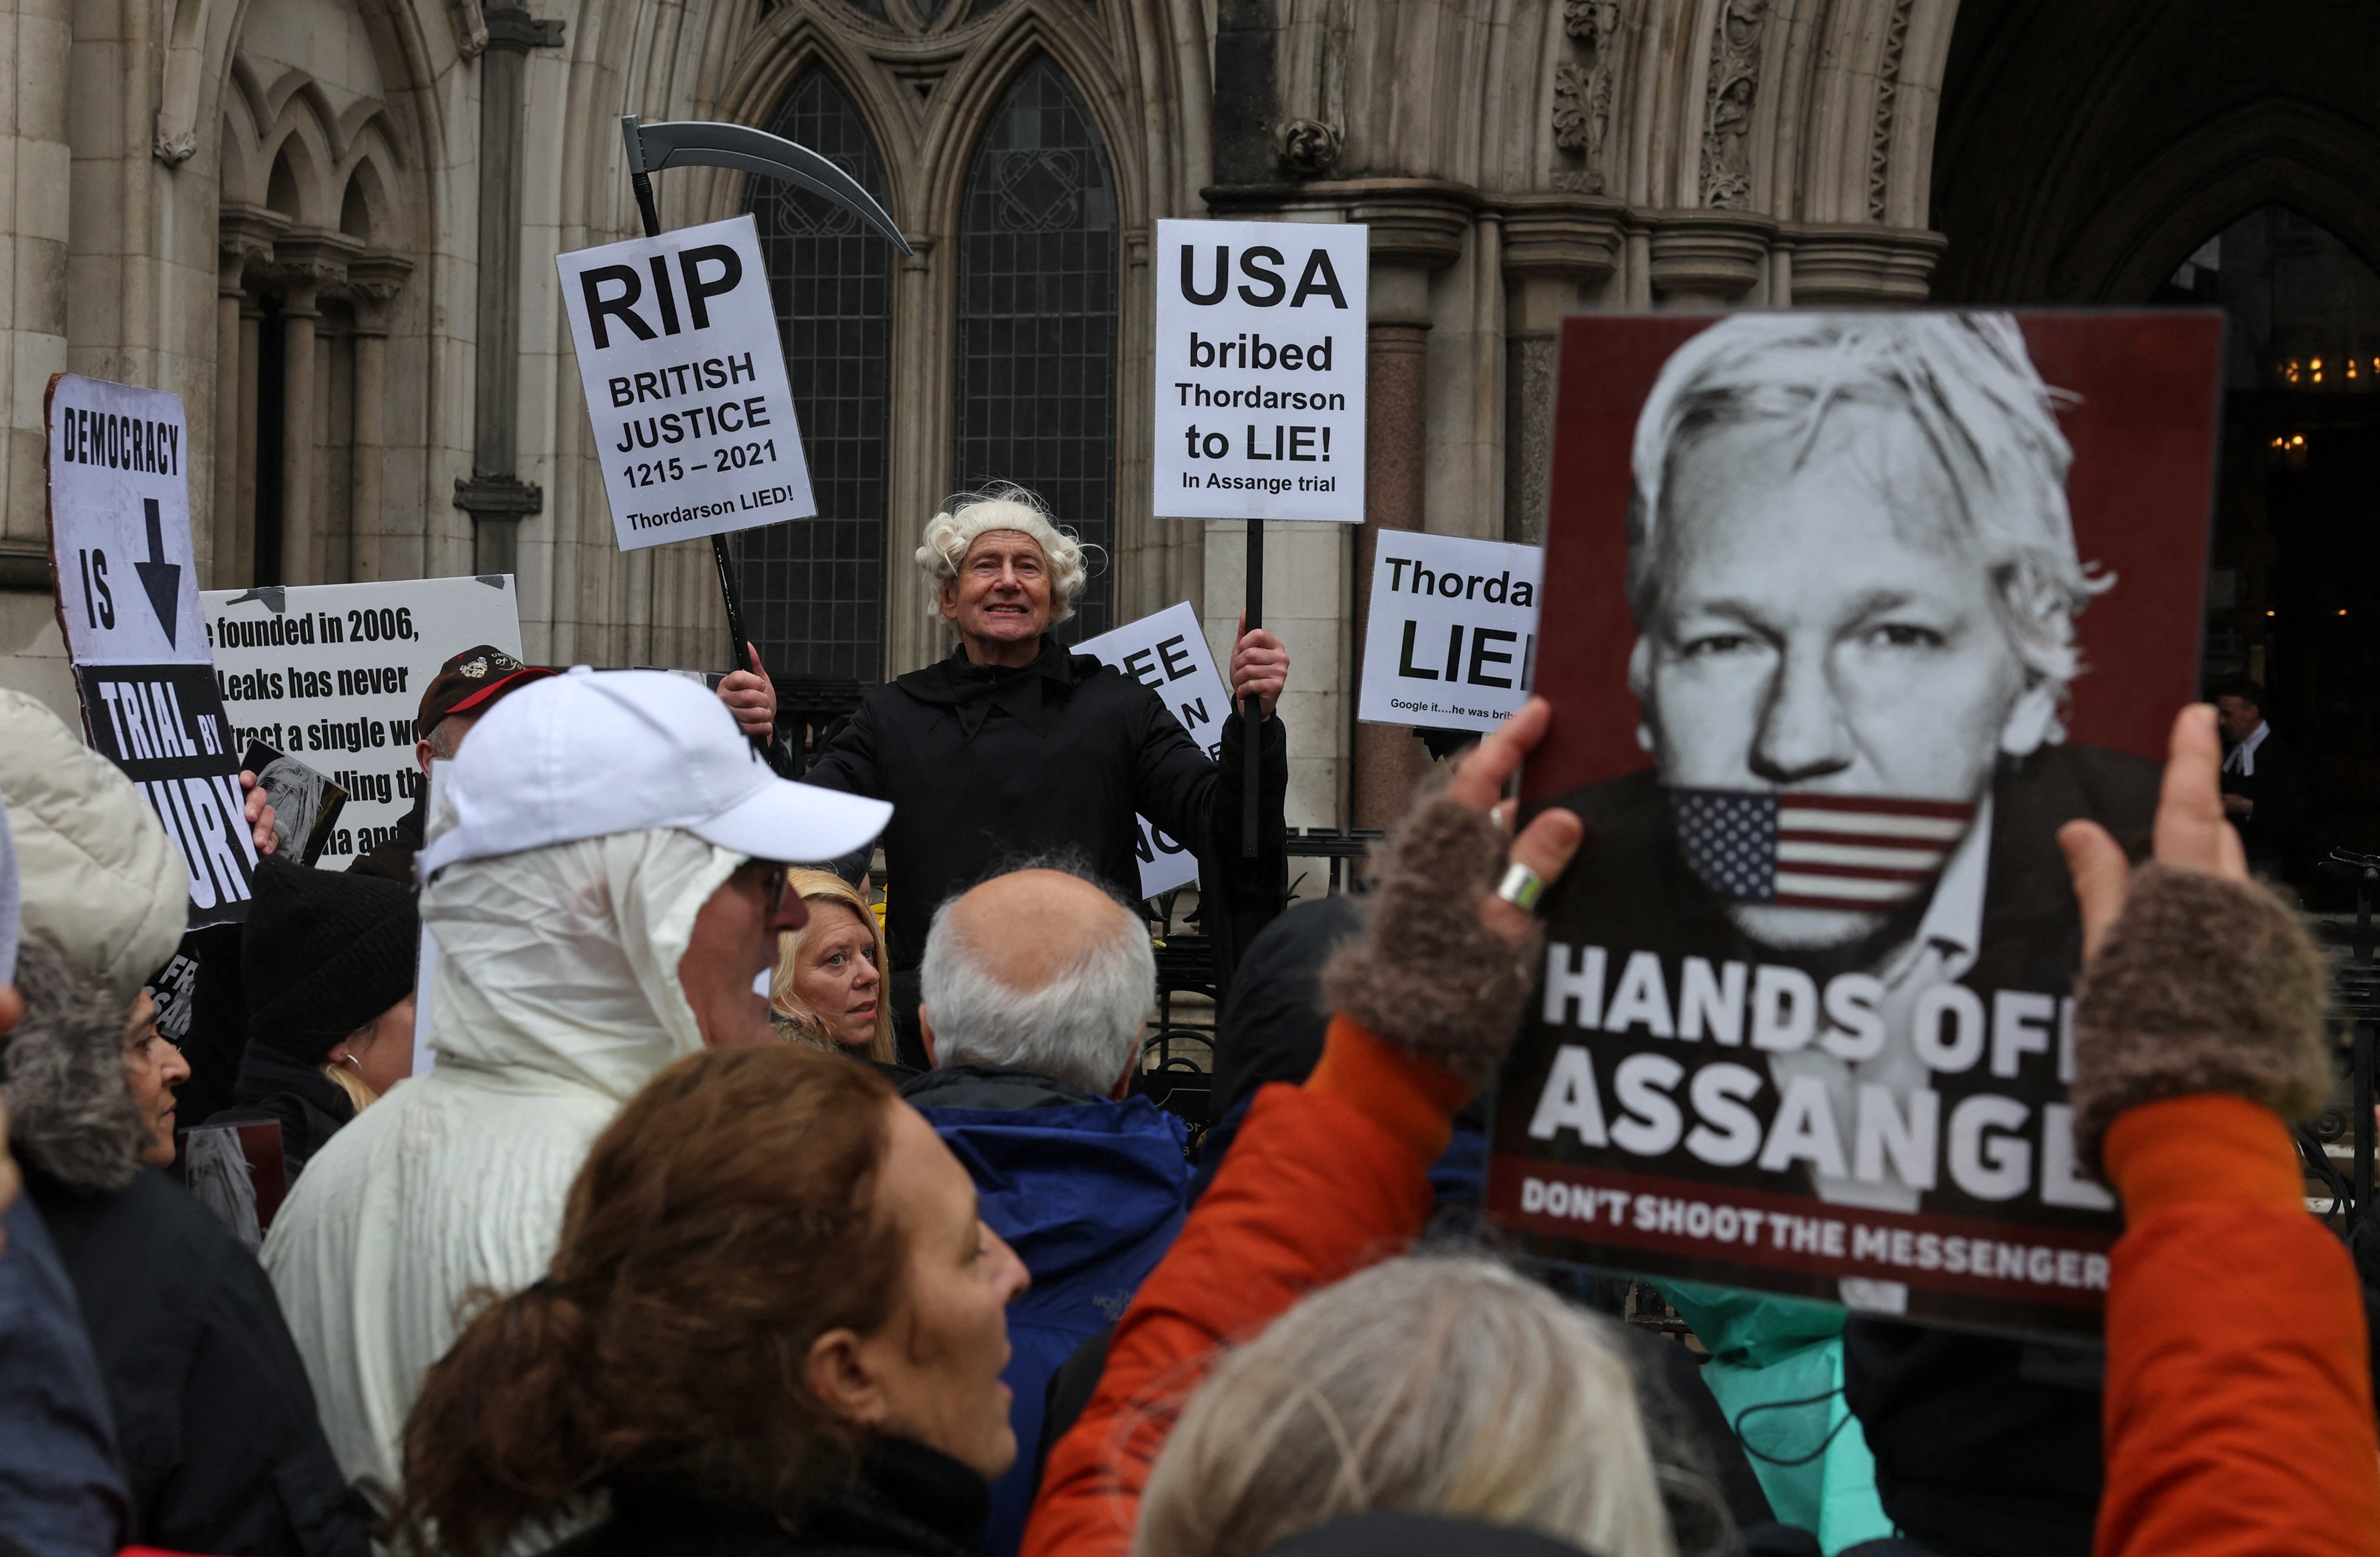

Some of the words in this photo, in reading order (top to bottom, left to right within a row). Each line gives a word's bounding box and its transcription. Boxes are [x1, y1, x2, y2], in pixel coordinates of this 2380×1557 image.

[580, 244, 743, 350] RIP
[1179, 245, 1348, 309] USA
[1189, 333, 1332, 371] bribed
[608, 352, 756, 408] BRITISH
[1175, 383, 1345, 411] Thordarson
[64, 407, 178, 475] DEMOCRACY
[616, 396, 771, 452] JUSTICE
[1185, 424, 1229, 459] to
[1247, 425, 1331, 462] LIE!
[624, 457, 684, 488] 1215
[714, 439, 777, 472] 2021
[1182, 472, 1200, 488] In
[1206, 472, 1292, 494] Assange
[1298, 475, 1335, 492] trial
[627, 500, 735, 531] Thordarson
[740, 485, 794, 511] LIED!
[80, 549, 114, 629] IS
[1385, 557, 1537, 607] Thorda
[217, 612, 315, 648] founded
[319, 612, 343, 643] in
[348, 607, 418, 643] 2006,
[288, 668, 333, 698] has
[337, 666, 409, 696] never
[1104, 634, 1197, 689] EE
[98, 682, 198, 760] TRIAL
[198, 715, 223, 755] BY
[288, 726, 303, 751] a
[308, 716, 386, 752] single
[1391, 698, 1428, 712] Google
[1468, 708, 1489, 718] was
[134, 774, 260, 909] URY
[1544, 941, 1887, 1061] HANDS
[1521, 1178, 1627, 1227] DON'T
[1634, 1193, 1770, 1245] SHOOT
[1767, 1207, 1844, 1257] THE
[1852, 1221, 2110, 1290] MESSENGER
